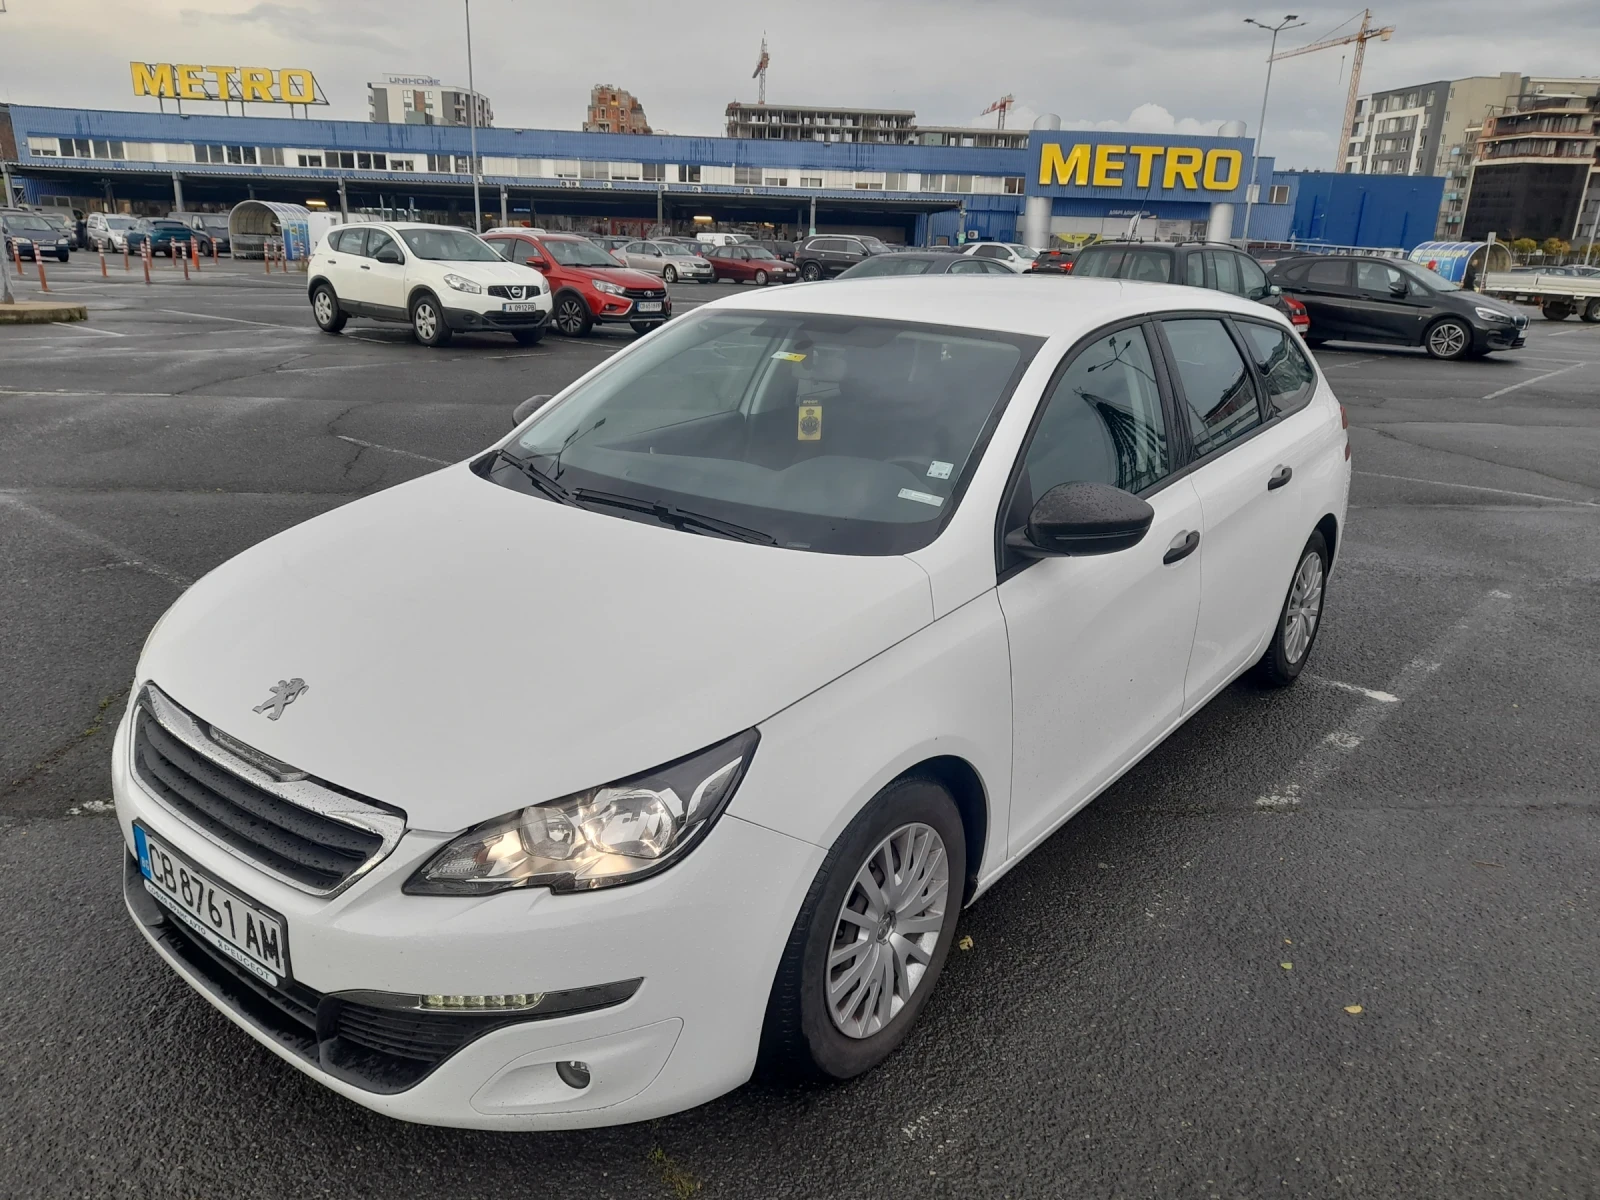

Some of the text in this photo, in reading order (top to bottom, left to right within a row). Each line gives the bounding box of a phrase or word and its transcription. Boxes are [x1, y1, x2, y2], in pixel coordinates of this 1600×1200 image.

[130, 61, 315, 104] METRO
[389, 77, 441, 86] UNIHOME
[1038, 142, 1243, 192] METRO
[149, 843, 281, 971] CB 8761 AM
[223, 944, 271, 980] PEUGEOT
